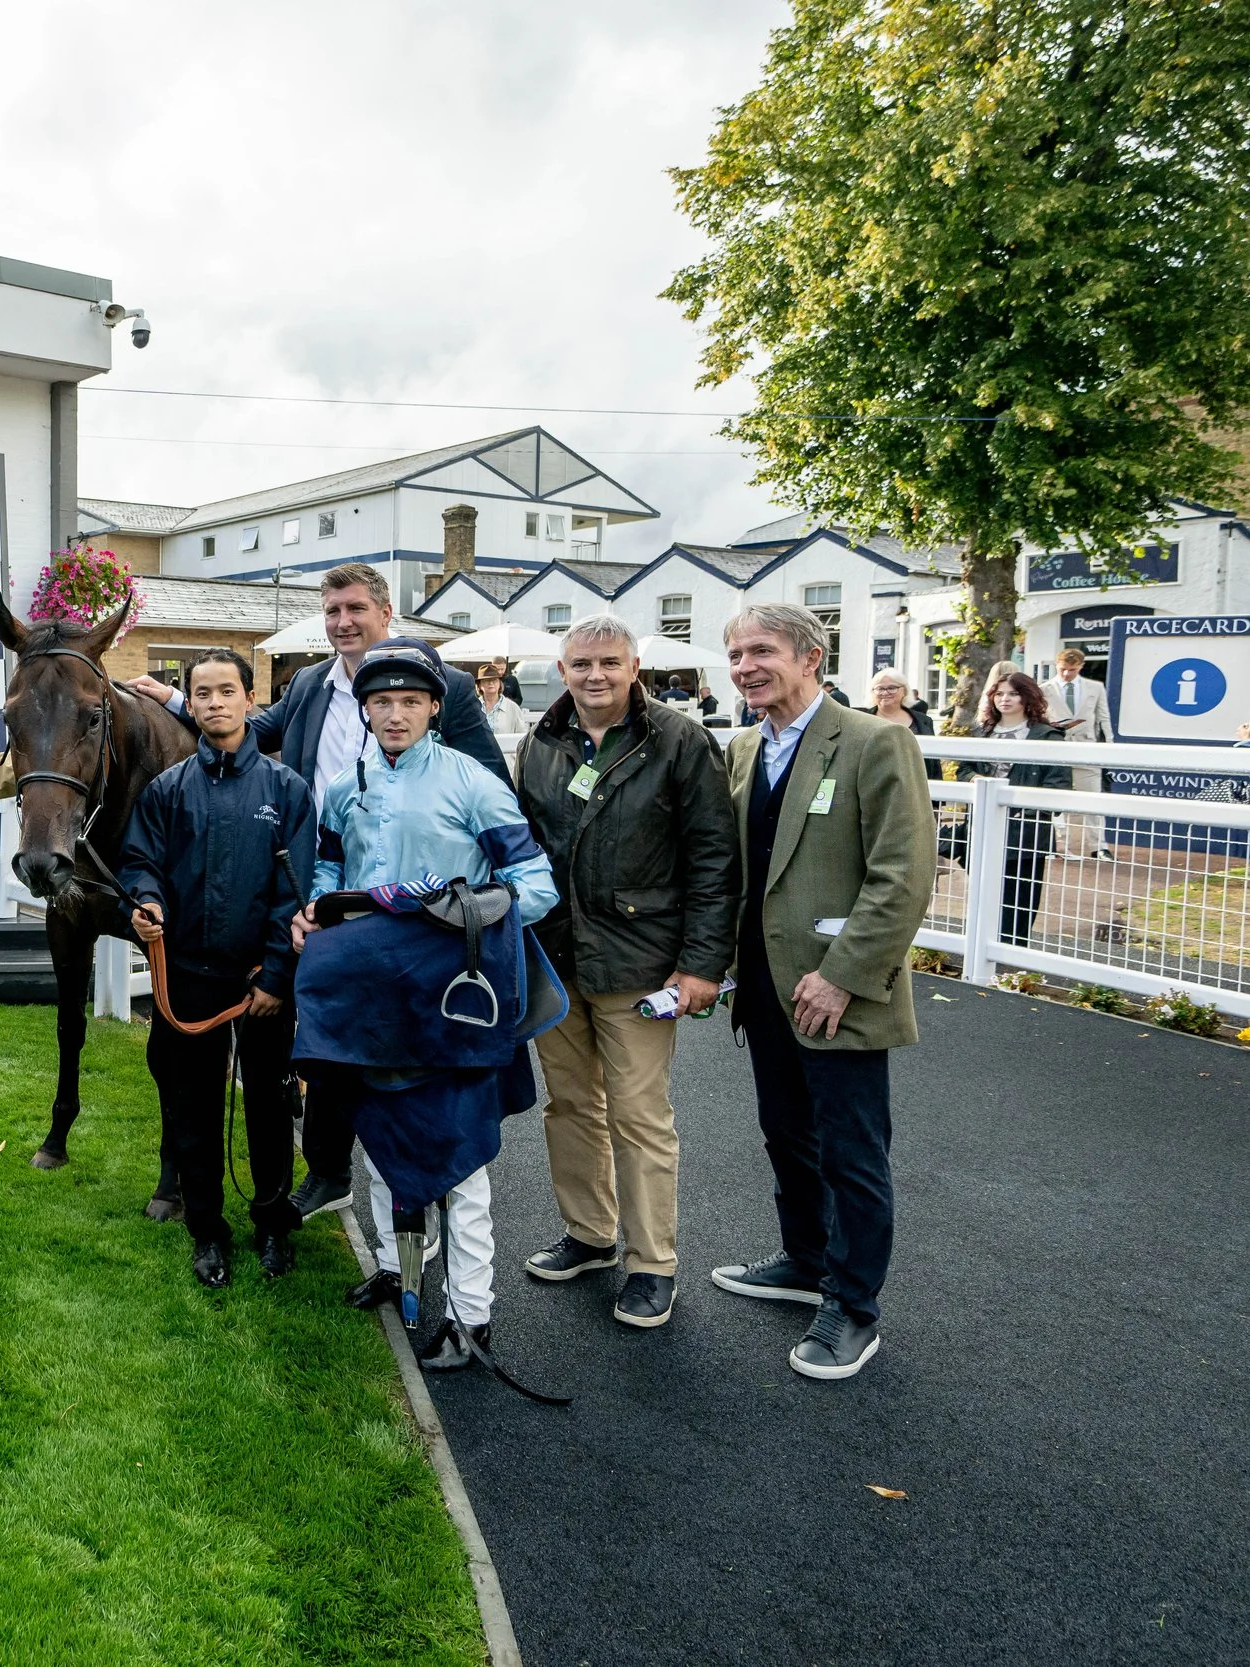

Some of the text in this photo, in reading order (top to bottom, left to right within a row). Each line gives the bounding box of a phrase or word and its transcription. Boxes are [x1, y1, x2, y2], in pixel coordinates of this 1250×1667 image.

[1052, 575, 1096, 589] Coffee
[1086, 644, 1110, 652] Welc
[1131, 787, 1196, 799] RACECOU
